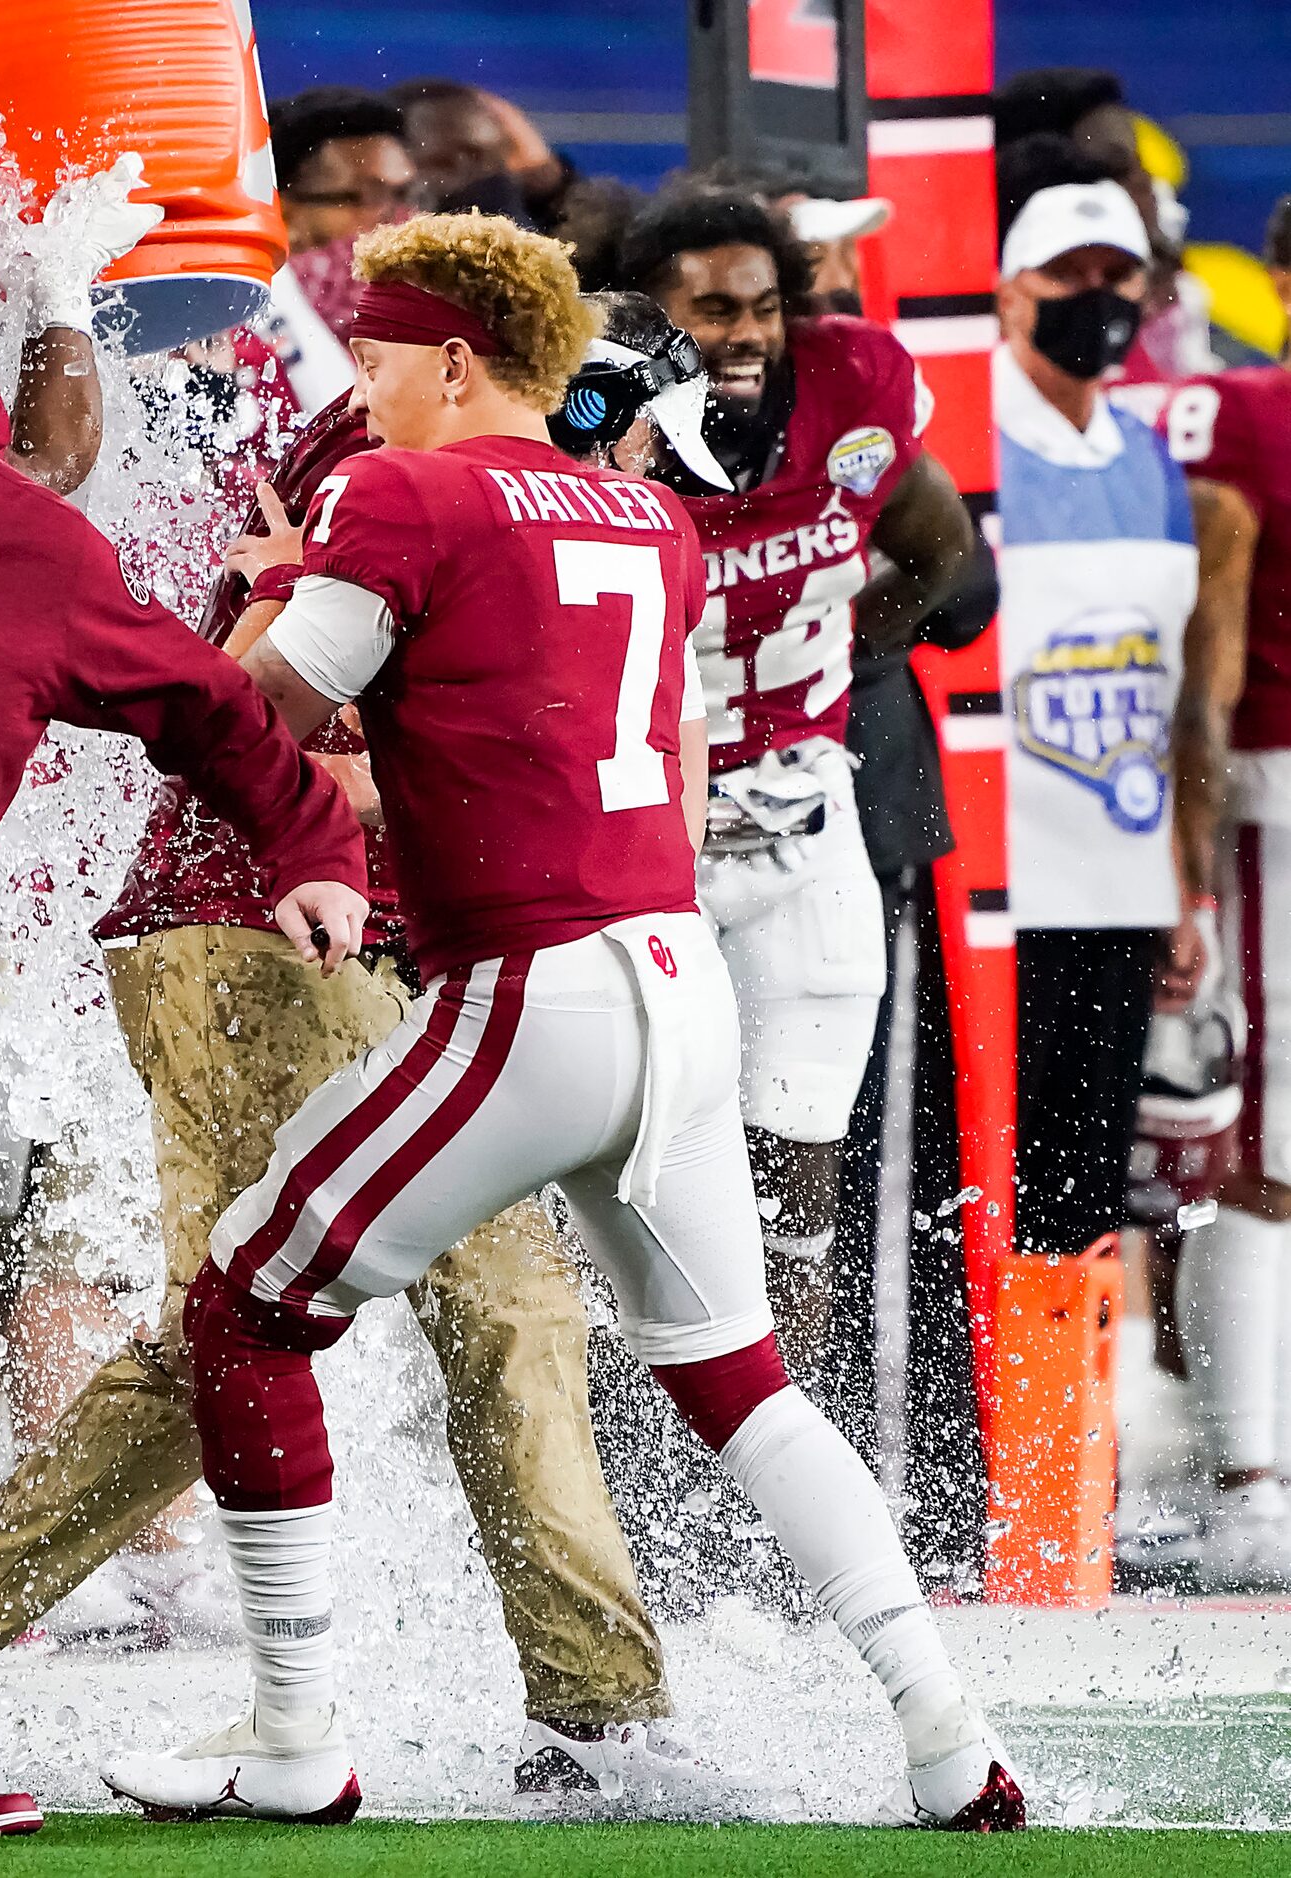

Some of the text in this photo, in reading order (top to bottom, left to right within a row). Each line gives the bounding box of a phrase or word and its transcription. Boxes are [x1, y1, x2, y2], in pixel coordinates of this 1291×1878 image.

[639, 366, 657, 392] AT&T
[311, 474, 351, 544] 7
[486, 467, 675, 531] RATTLER
[552, 539, 670, 813] 7
[647, 934, 677, 979] OU
